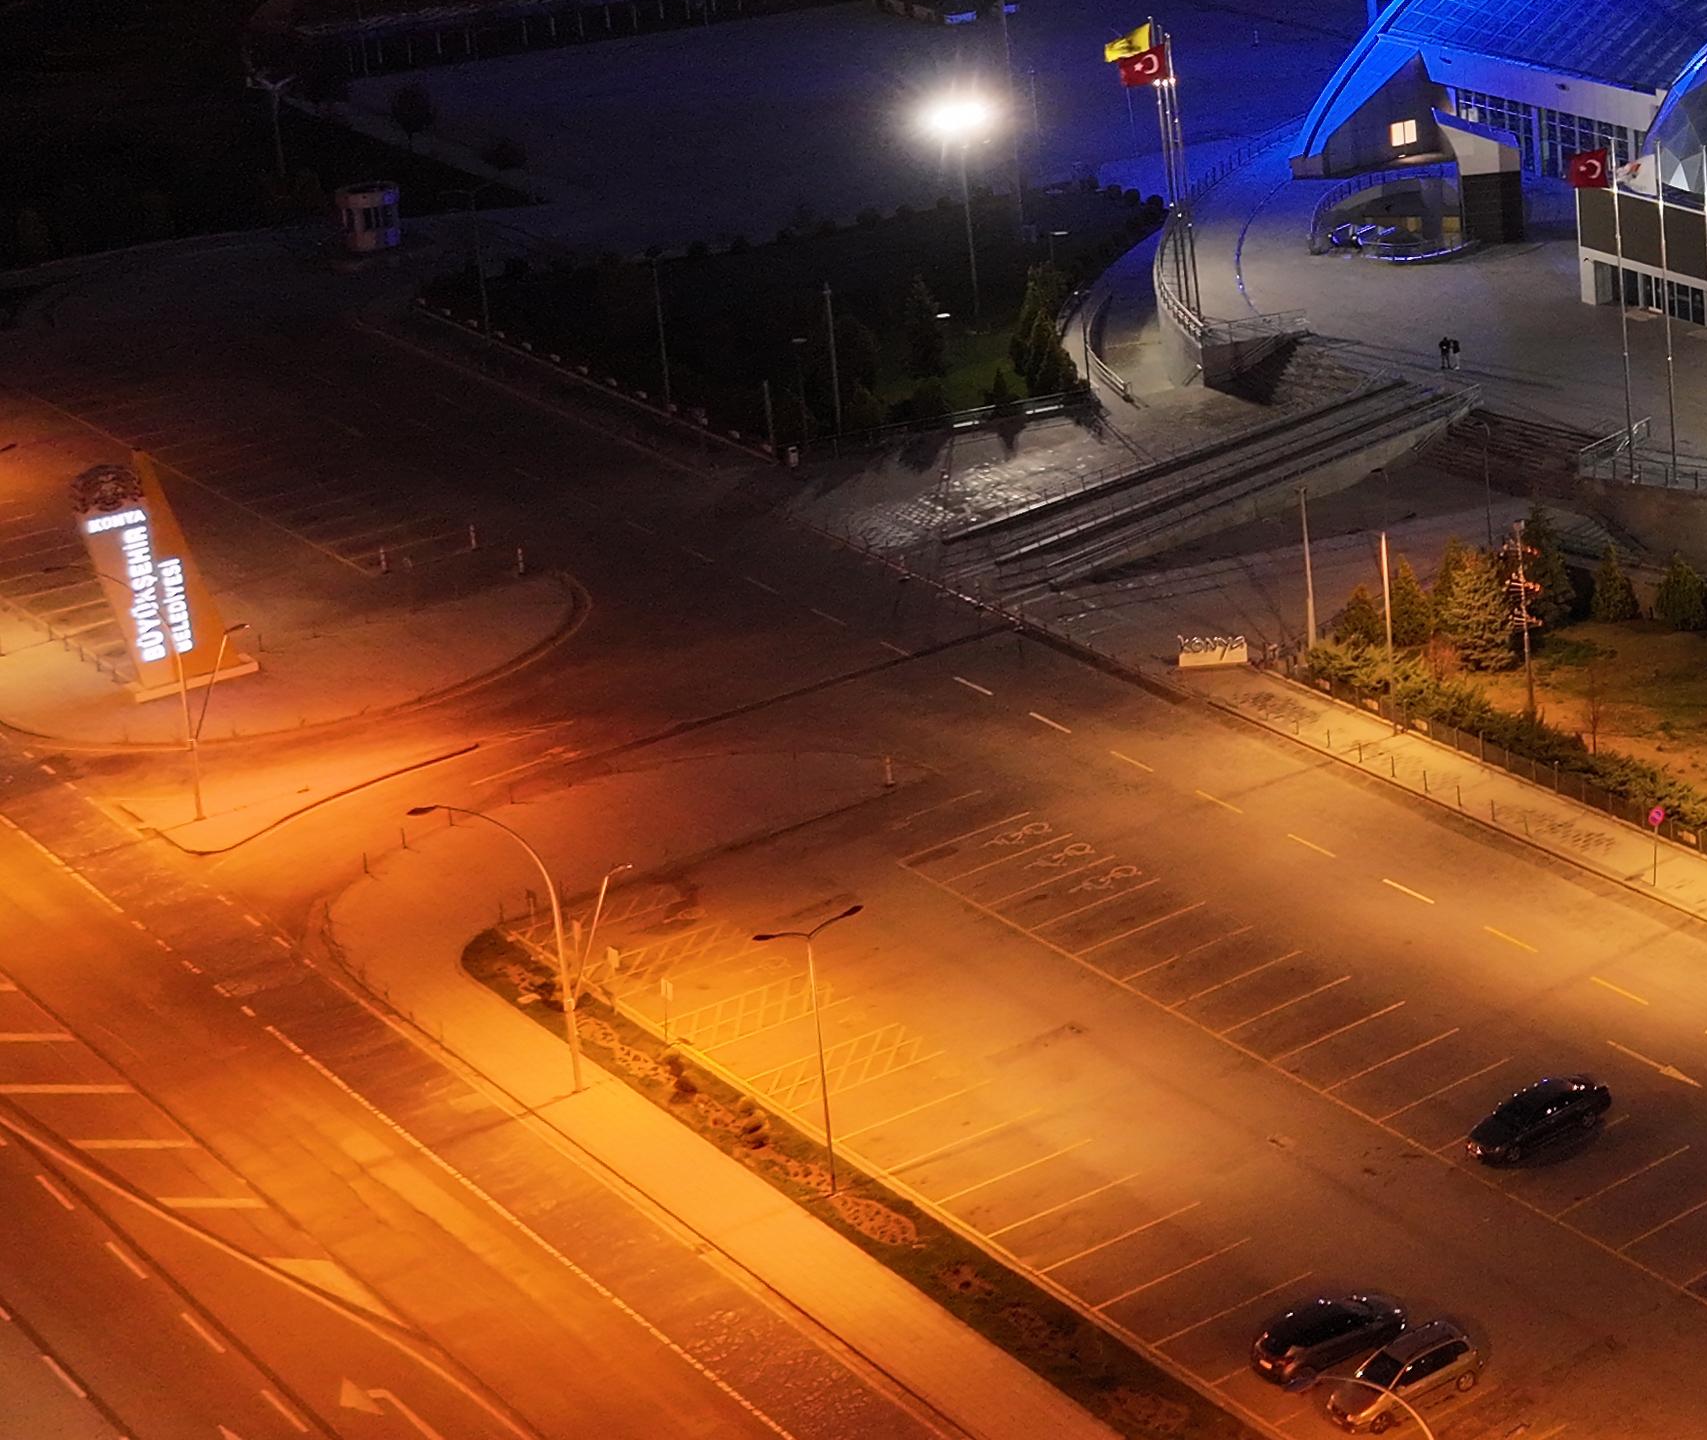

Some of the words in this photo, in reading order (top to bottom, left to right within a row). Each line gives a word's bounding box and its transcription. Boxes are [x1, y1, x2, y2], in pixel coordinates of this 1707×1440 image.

[87, 510, 147, 534] KONYA
[122, 526, 166, 662] BÜYÜKŞEHİR
[157, 558, 193, 653] BELEDİYESİ
